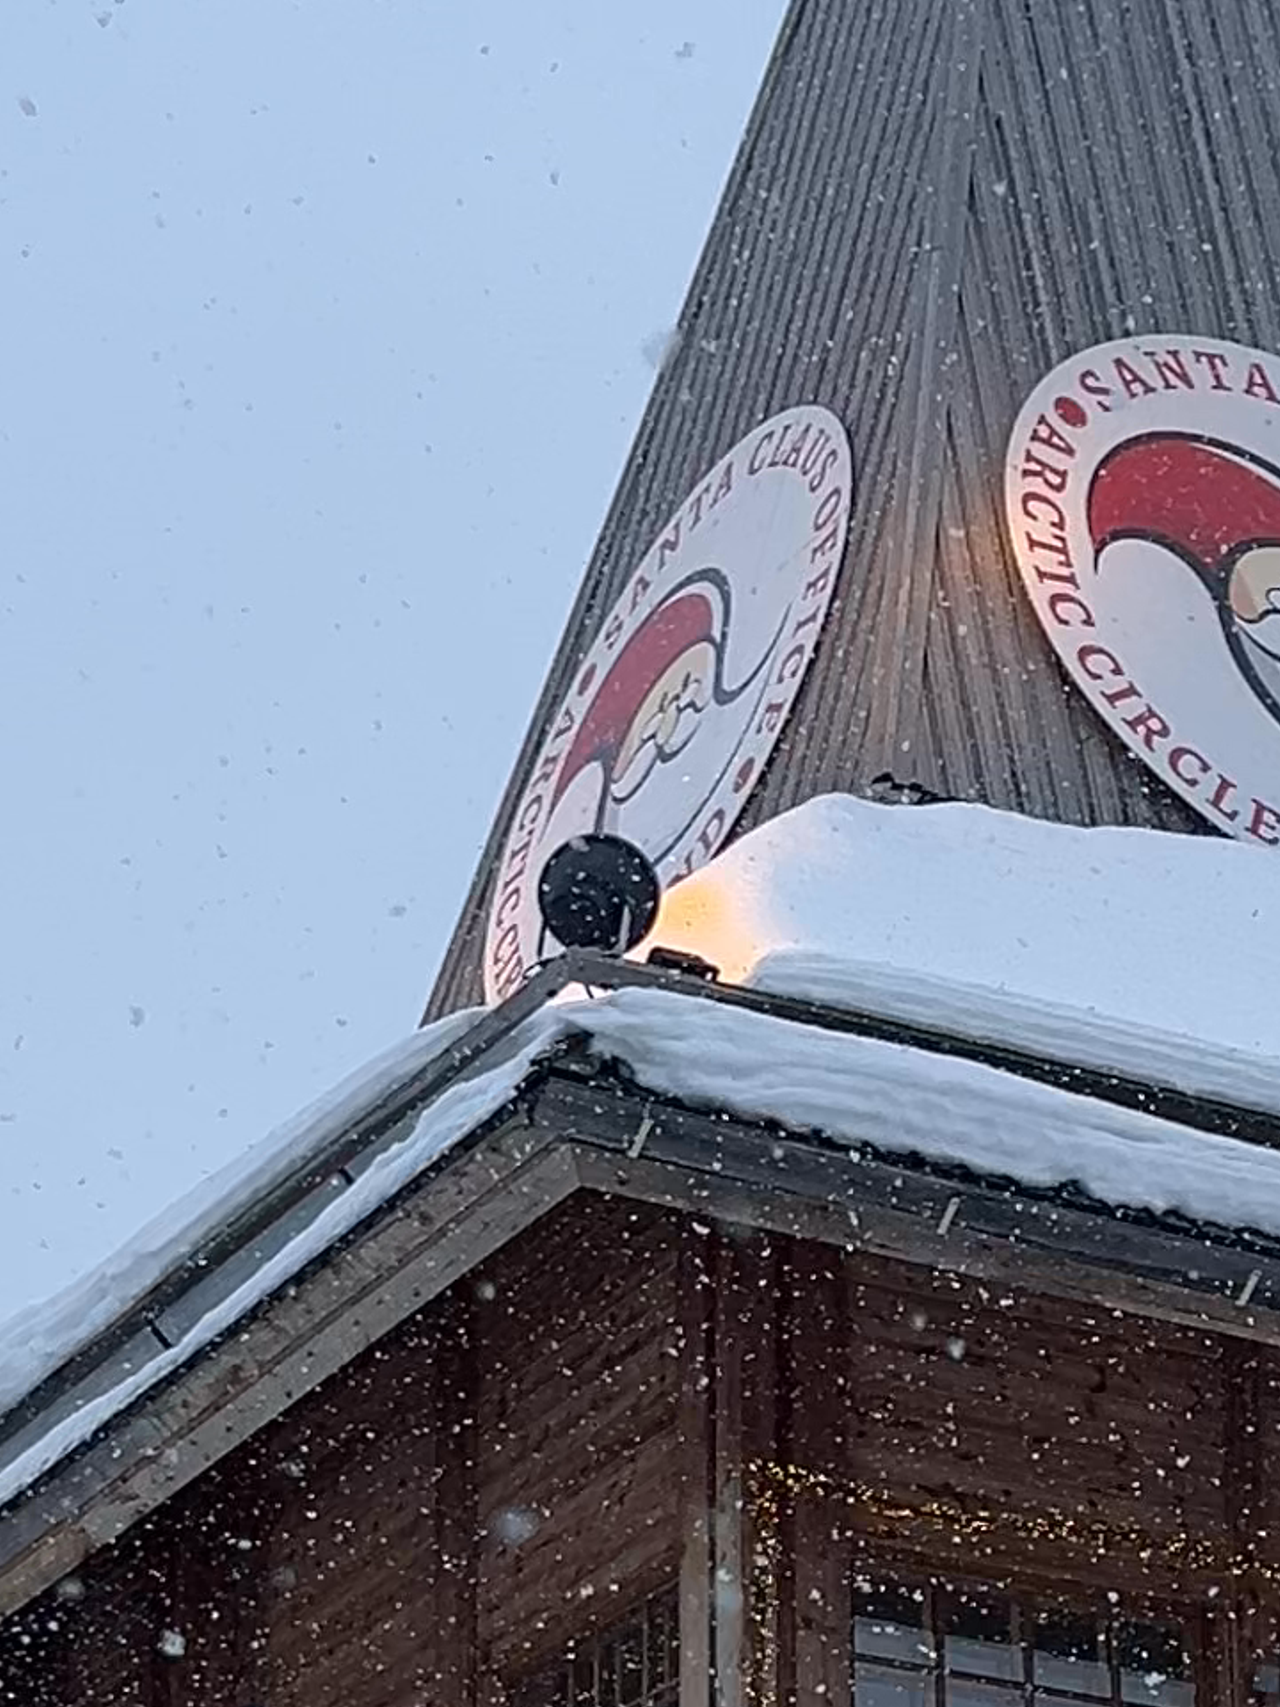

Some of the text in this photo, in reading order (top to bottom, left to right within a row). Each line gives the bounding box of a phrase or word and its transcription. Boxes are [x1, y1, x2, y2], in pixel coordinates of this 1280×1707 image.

[604, 422, 842, 734] SANTA CLAUS OFFICE
[1020, 414, 1096, 628] ARCTIC
[495, 707, 575, 928] ARCTIC
